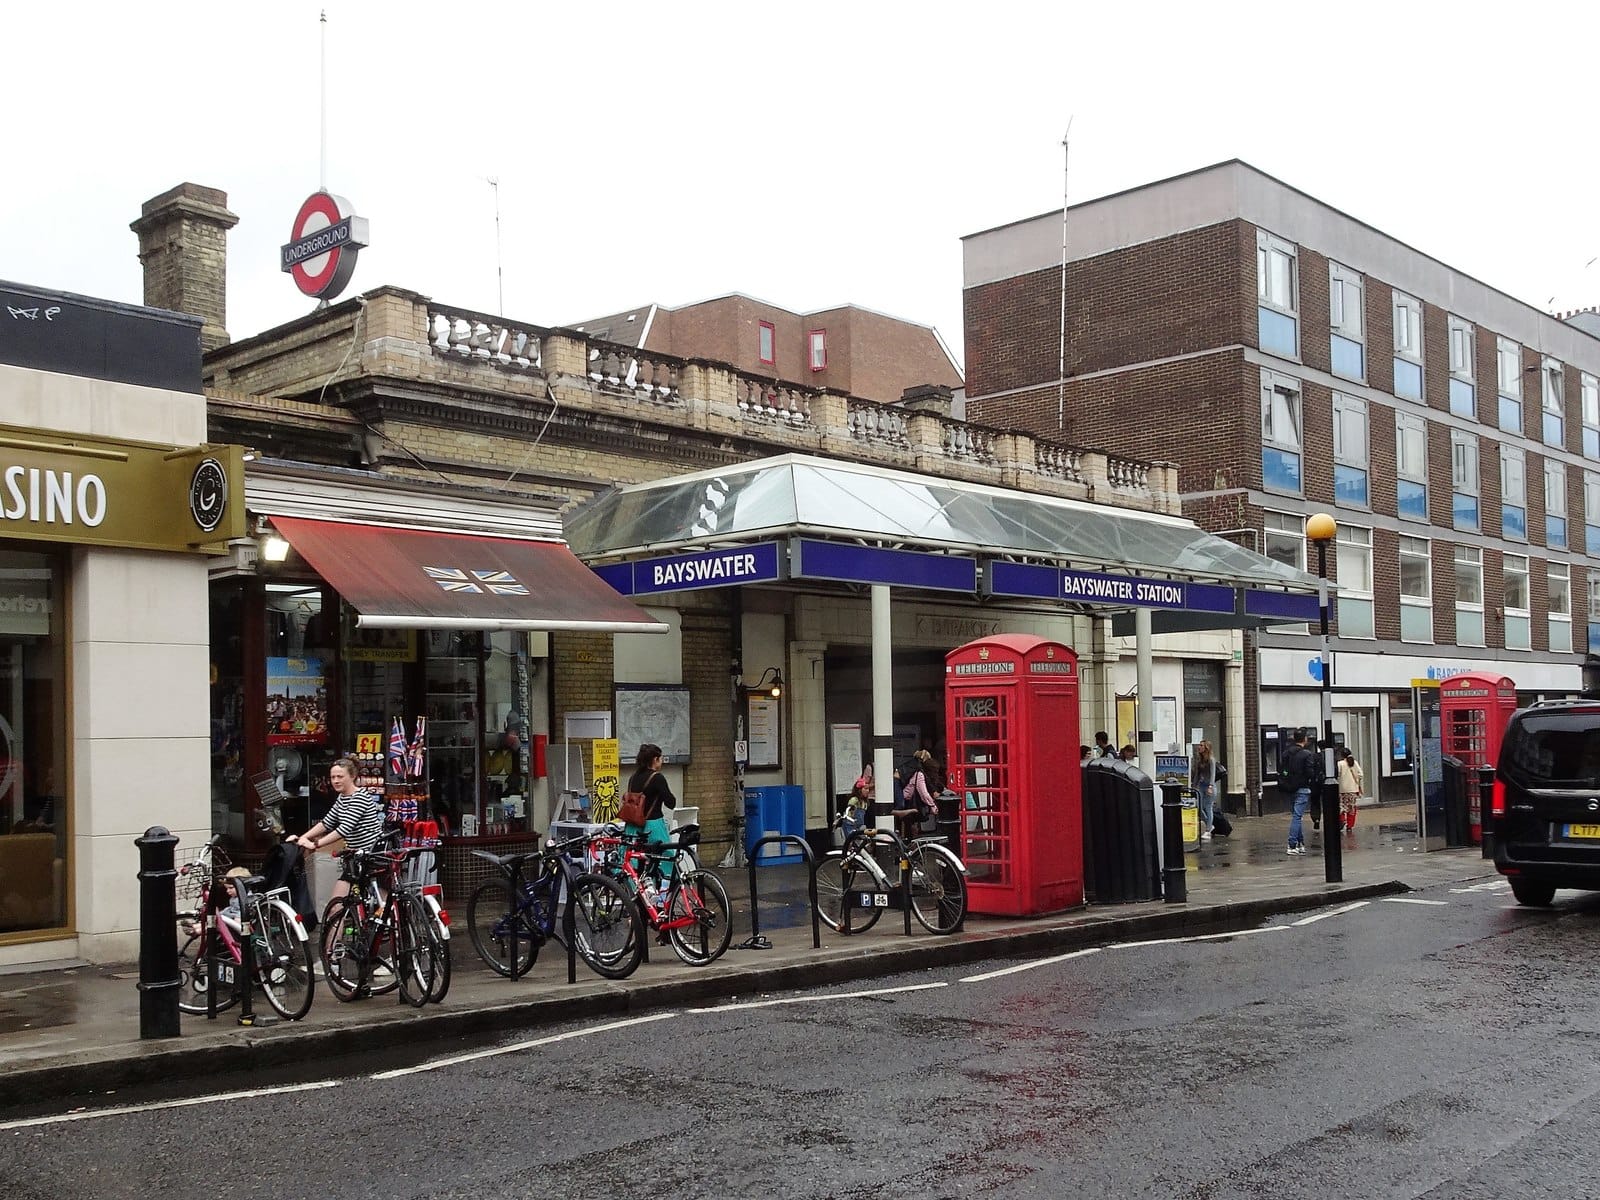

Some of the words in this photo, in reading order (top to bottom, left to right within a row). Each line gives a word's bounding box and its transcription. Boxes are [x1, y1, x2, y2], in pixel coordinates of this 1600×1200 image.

[285, 226, 348, 262] UNDERGROUND
[0, 465, 107, 527] SINO
[654, 553, 756, 586] BAYSWATER
[1064, 575, 1133, 599] BAYSWATER
[1136, 583, 1182, 603] STATION
[958, 663, 1013, 674] TELEPHONE
[1031, 663, 1070, 671] TELEPHONE
[360, 737, 377, 753] £1
[1157, 757, 1174, 768] TICKET
[1175, 758, 1188, 768] DESK
[863, 894, 871, 905] P
